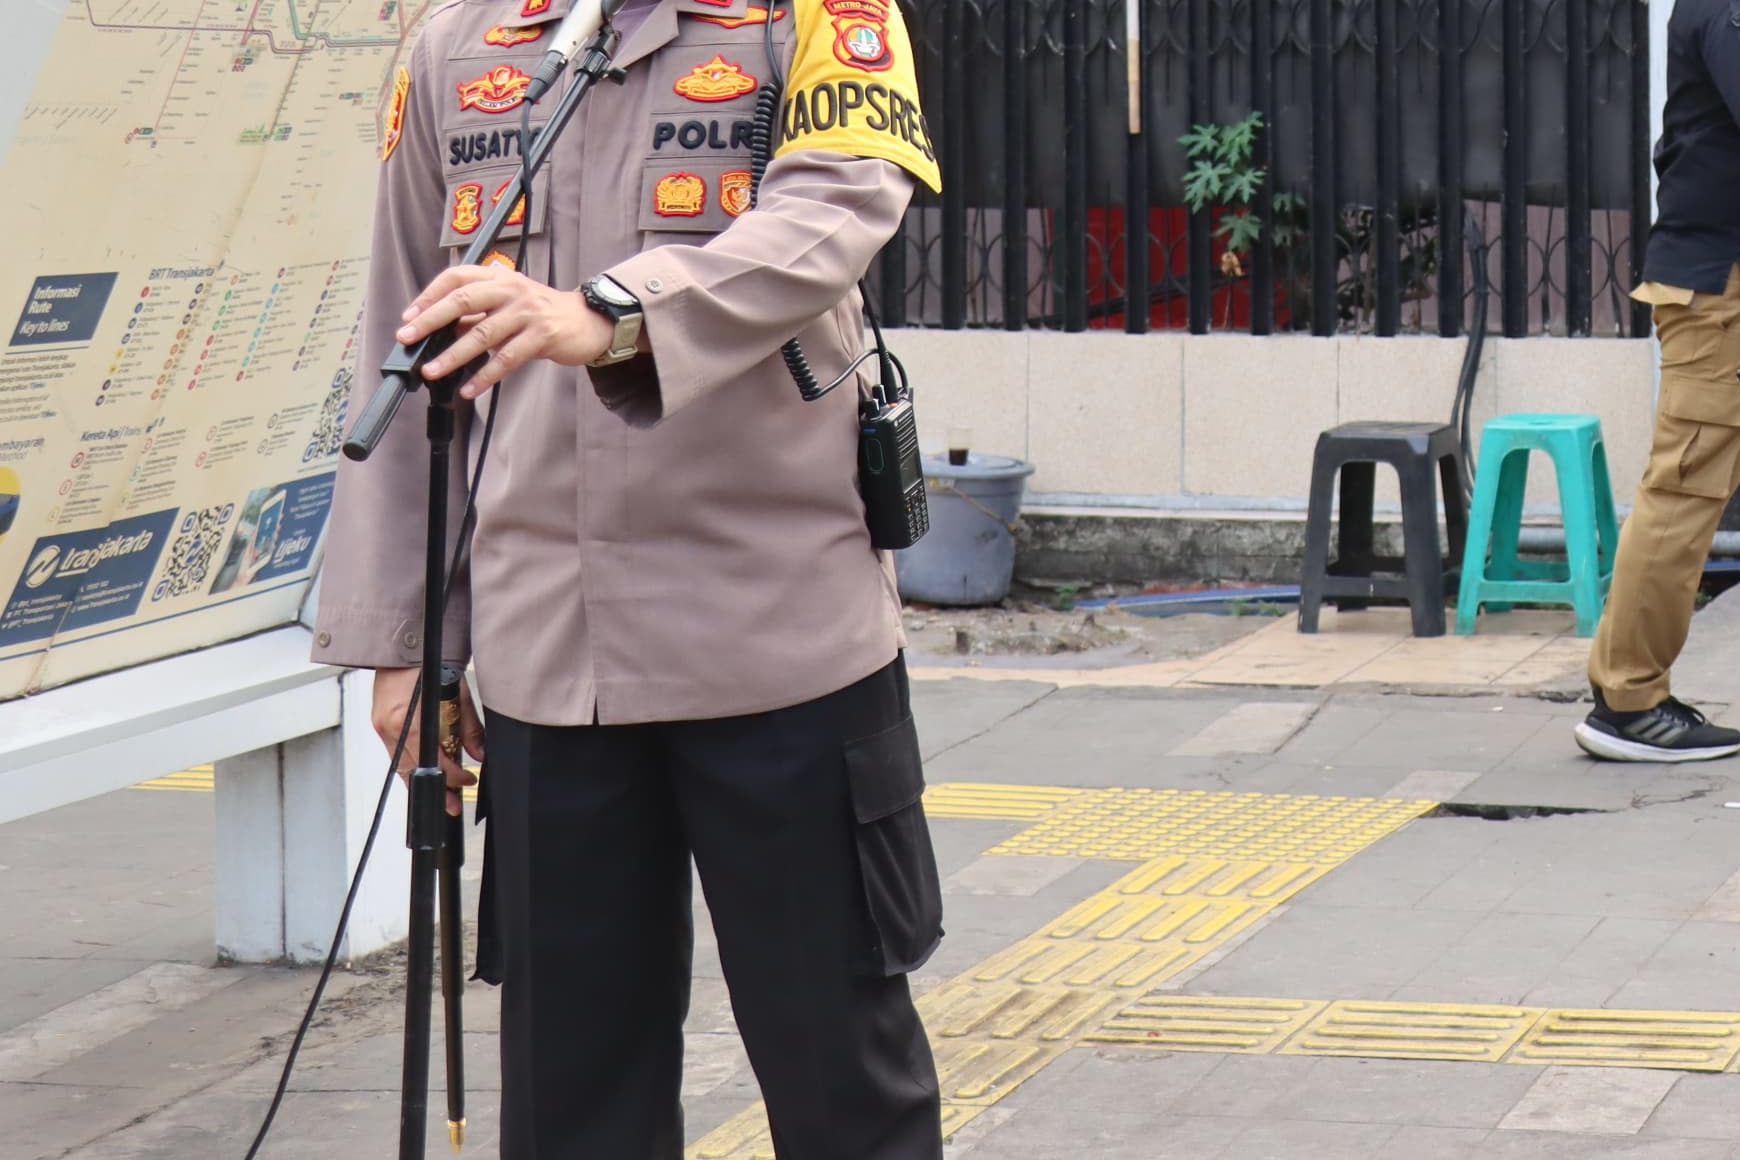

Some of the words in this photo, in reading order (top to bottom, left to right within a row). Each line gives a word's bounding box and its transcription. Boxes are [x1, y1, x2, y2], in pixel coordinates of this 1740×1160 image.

[653, 120, 754, 150] POLR
[33, 283, 83, 300] Informasi
[28, 300, 53, 314] Rute
[20, 320, 37, 337] Key
[36, 321, 47, 334] to
[46, 318, 71, 333] lines
[59, 529, 153, 571] transjakarta
